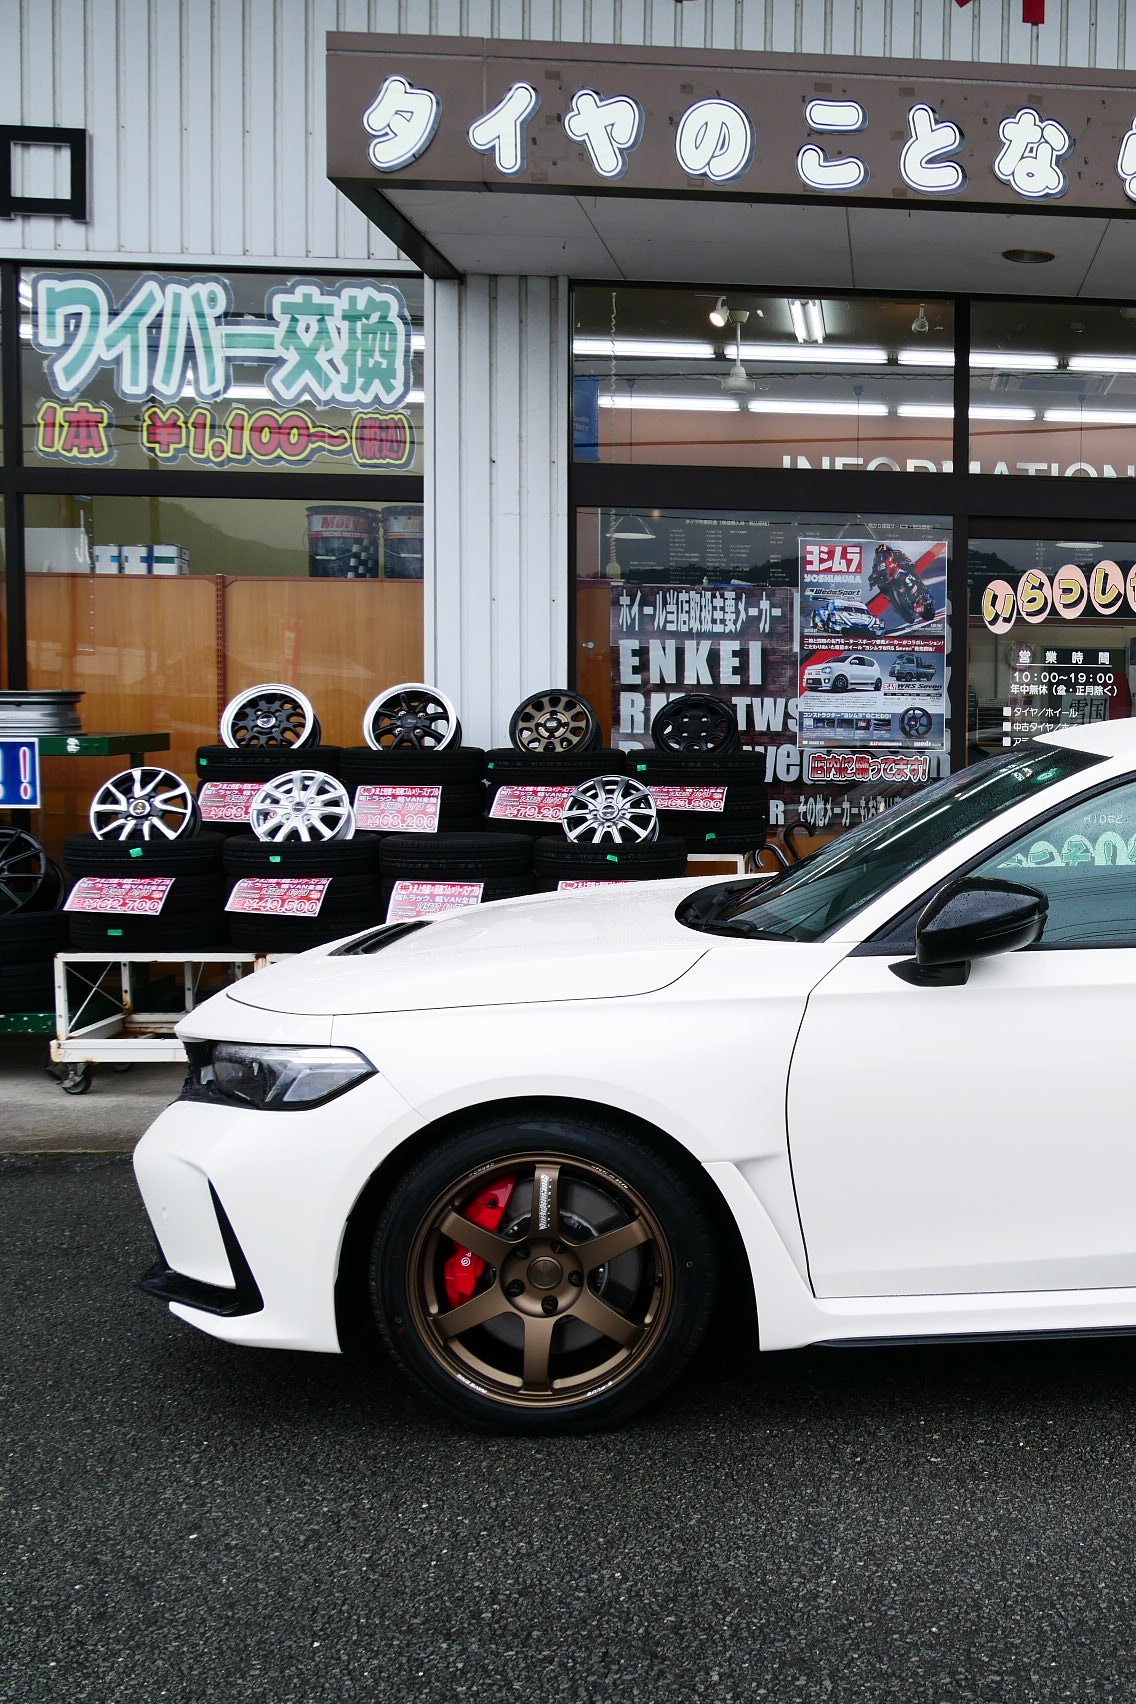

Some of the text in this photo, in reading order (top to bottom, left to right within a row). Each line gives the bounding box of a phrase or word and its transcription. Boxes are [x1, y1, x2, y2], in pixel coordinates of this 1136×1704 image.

[29, 272, 413, 409] ワイパー交換
[805, 545, 861, 573] ヨシムラ
[803, 574, 862, 583] YOSHIMURA
[619, 589, 782, 634] ホイール当店取扱主要メーカー
[619, 639, 762, 685] ENKEI
[1018, 650, 1111, 665] 営業時間
